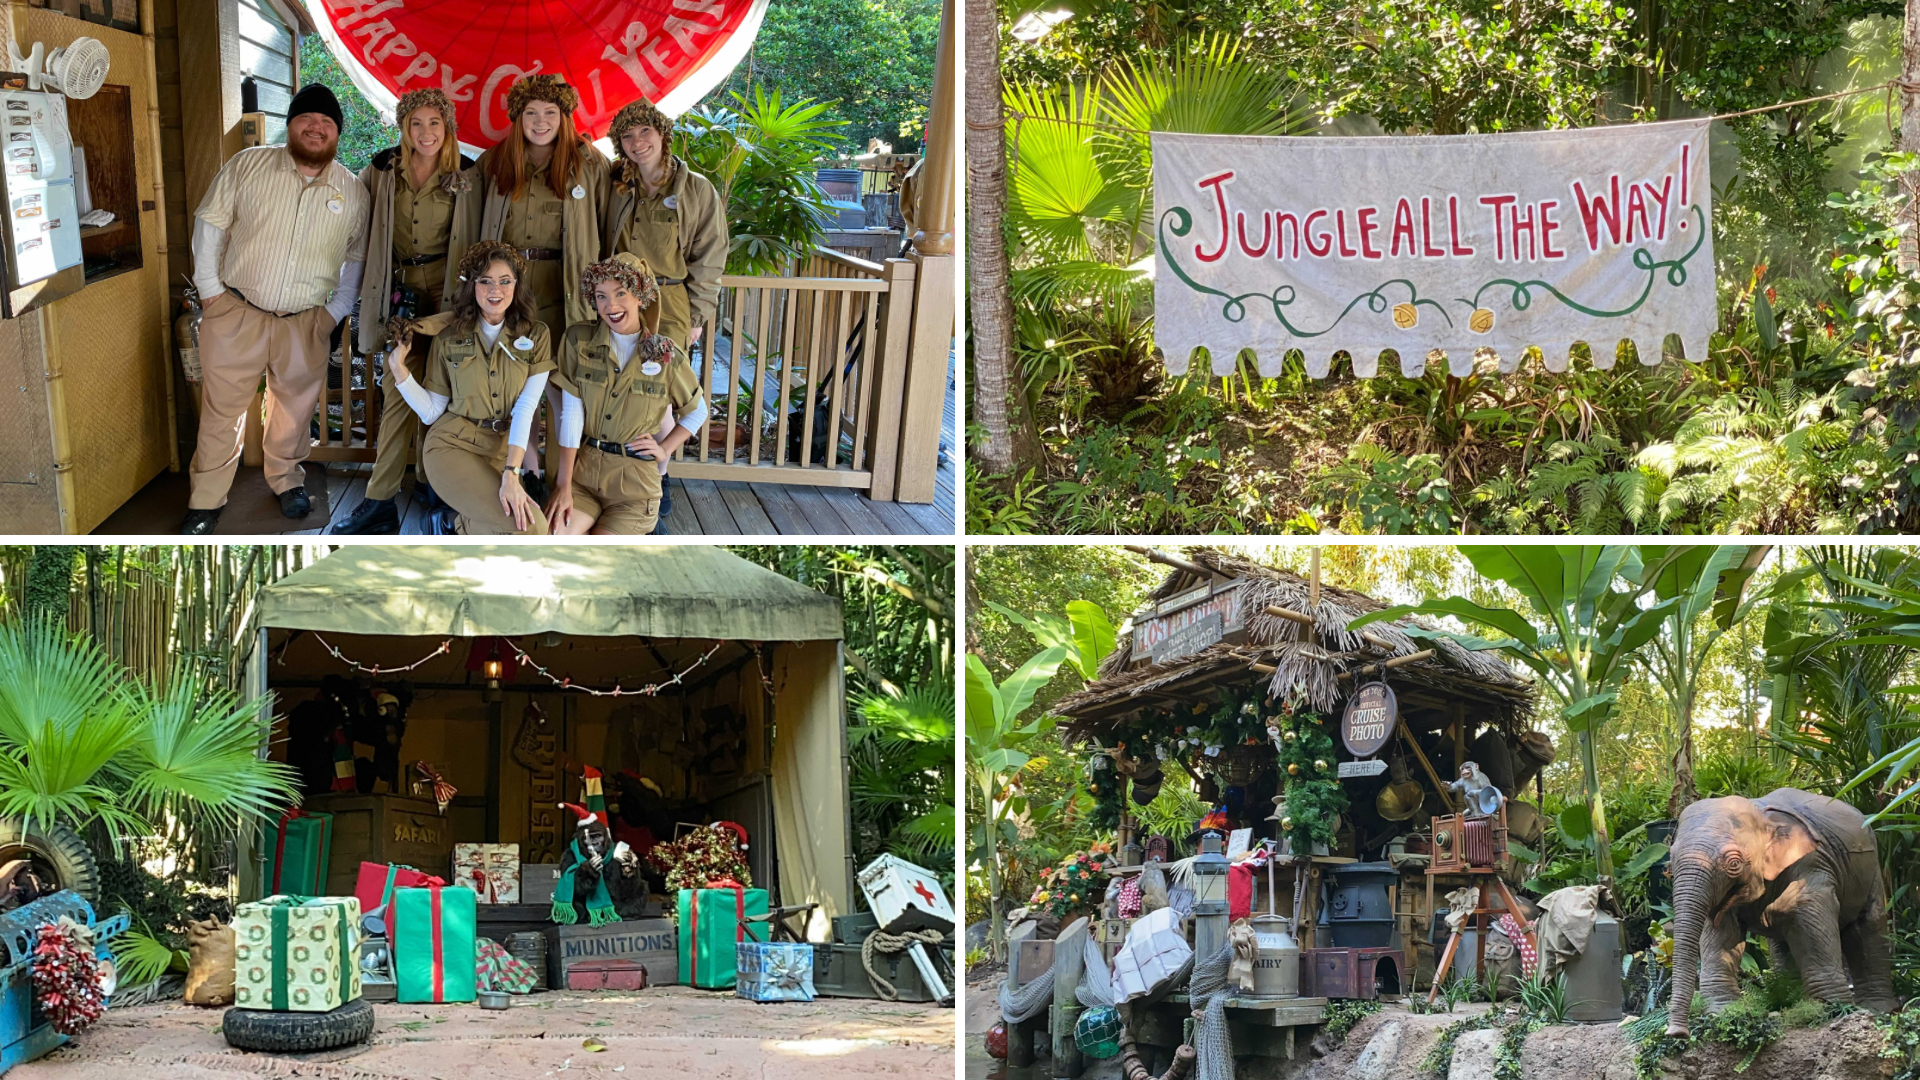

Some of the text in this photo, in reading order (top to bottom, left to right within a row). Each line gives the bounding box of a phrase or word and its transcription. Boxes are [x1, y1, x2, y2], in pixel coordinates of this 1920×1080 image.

[328, 0, 478, 102] HAPPY
[479, 59, 604, 142] GU
[1195, 144, 1689, 262] JUNGLE ALL THE WAY!
[1168, 632, 1187, 648] TRADER
[1189, 624, 1216, 654] SHOP!
[1350, 707, 1387, 725] CRUISE
[1349, 723, 1385, 741] PHOTO
[1349, 762, 1376, 775] HERE!
[394, 824, 441, 845] SAFARI
[566, 933, 673, 957] MUNITIONS
[1252, 958, 1283, 969] AIRY
